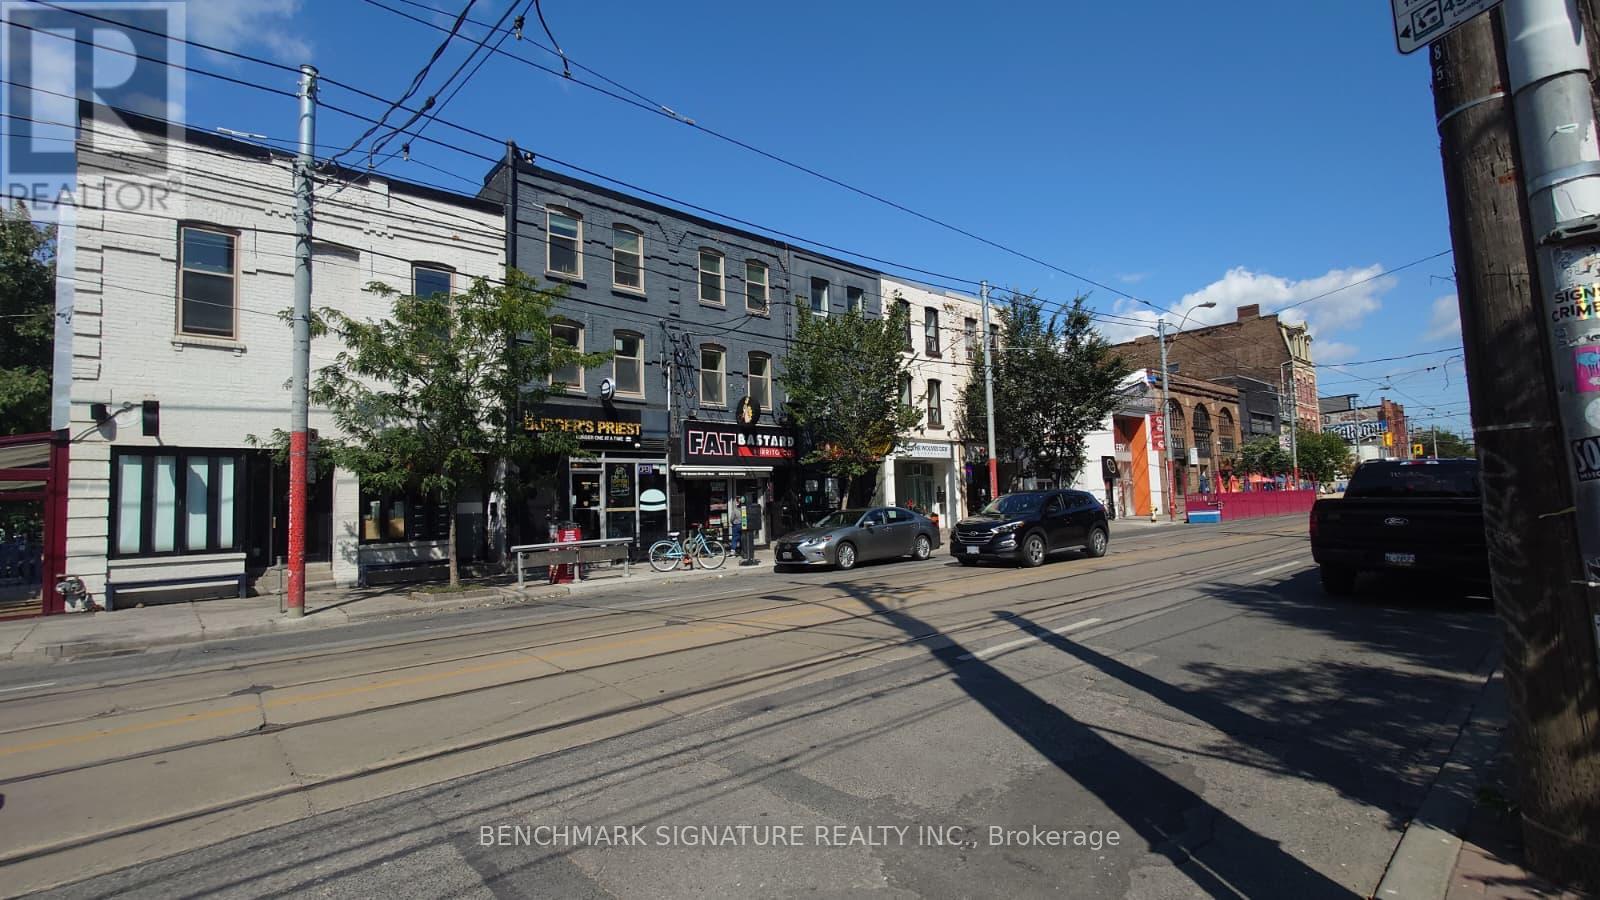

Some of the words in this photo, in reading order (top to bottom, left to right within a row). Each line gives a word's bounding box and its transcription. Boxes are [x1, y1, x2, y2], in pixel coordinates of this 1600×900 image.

[597, 421, 640, 435] PRIEST
[688, 430, 737, 456] FAT
[737, 433, 795, 447] BASTARD
